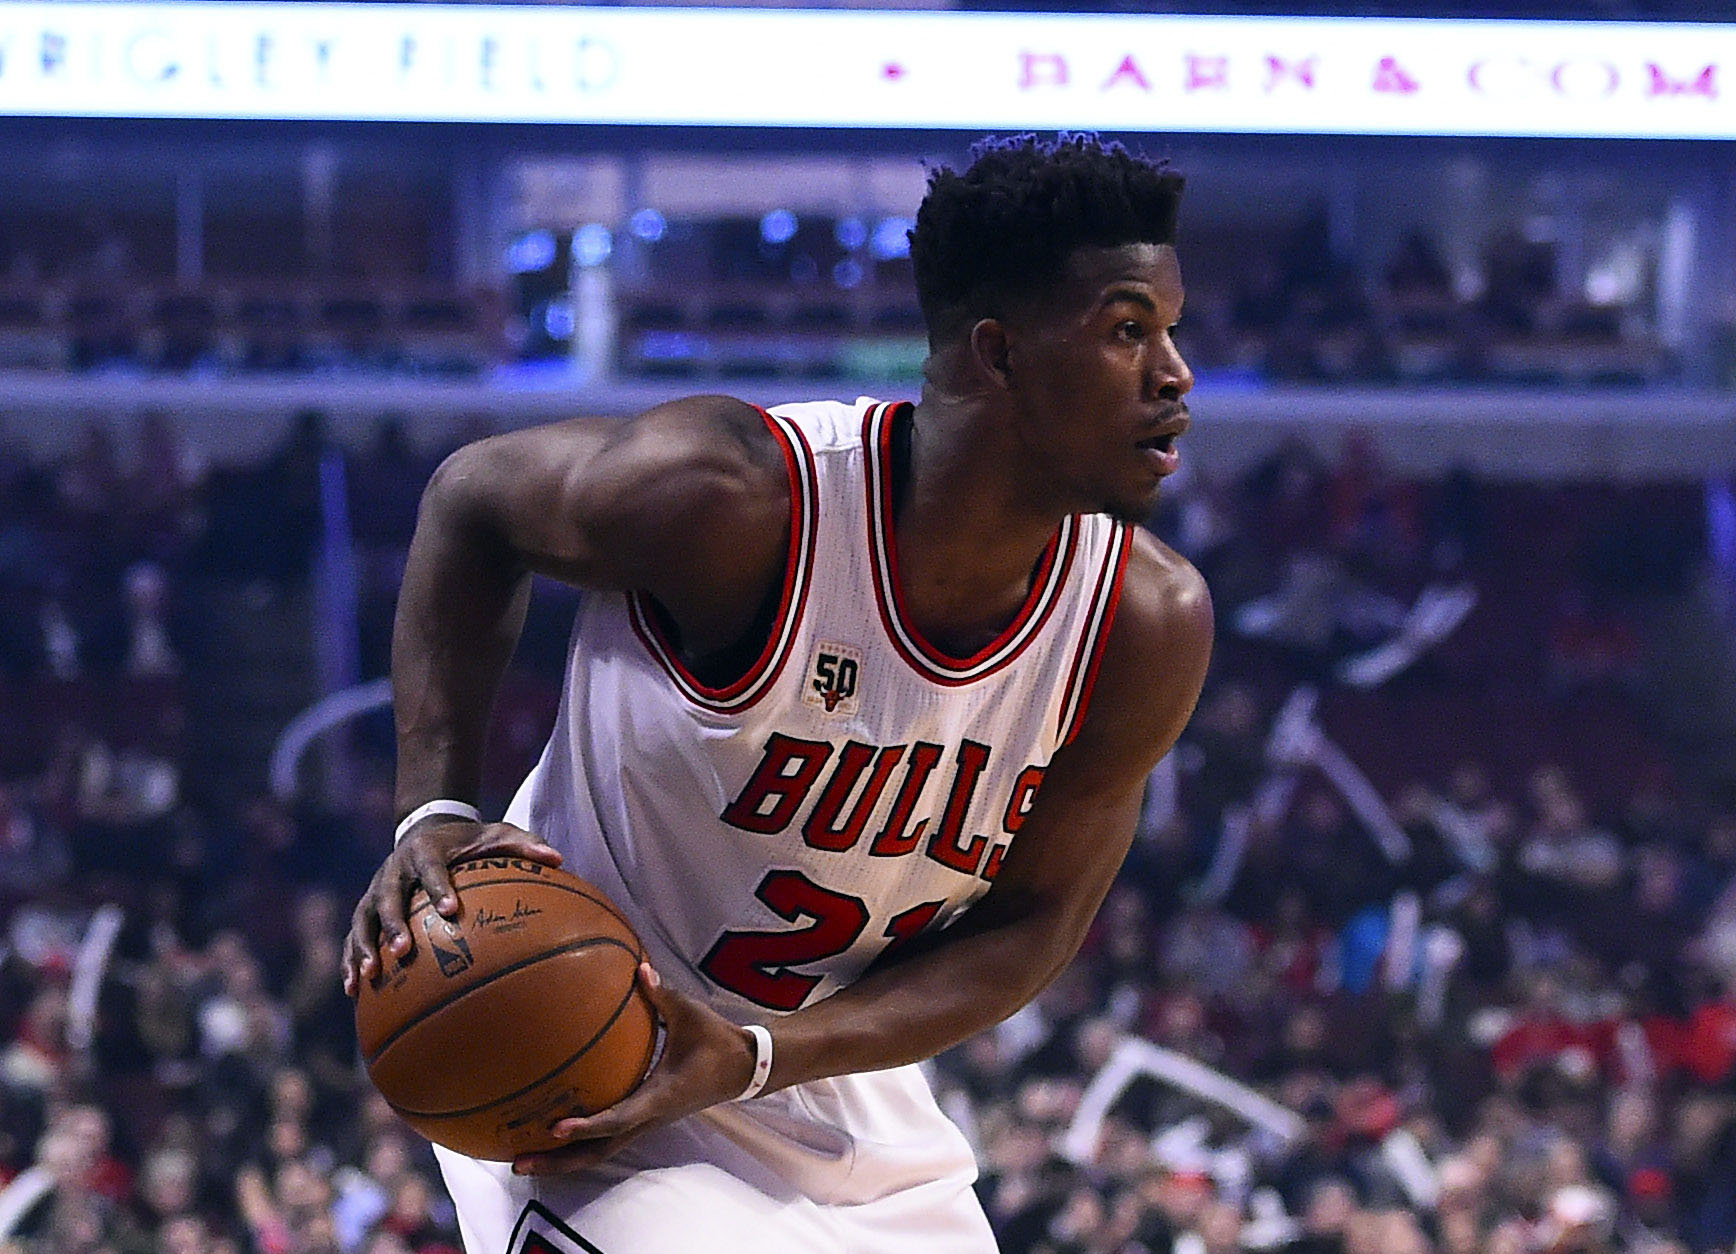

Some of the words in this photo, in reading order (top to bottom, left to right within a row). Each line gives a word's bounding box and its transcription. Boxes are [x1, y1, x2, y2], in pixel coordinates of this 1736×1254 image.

[0, 26, 342, 92] RIGLEY
[396, 29, 622, 96] FIELD
[1370, 53, 1422, 96] &
[814, 653, 858, 698] 50
